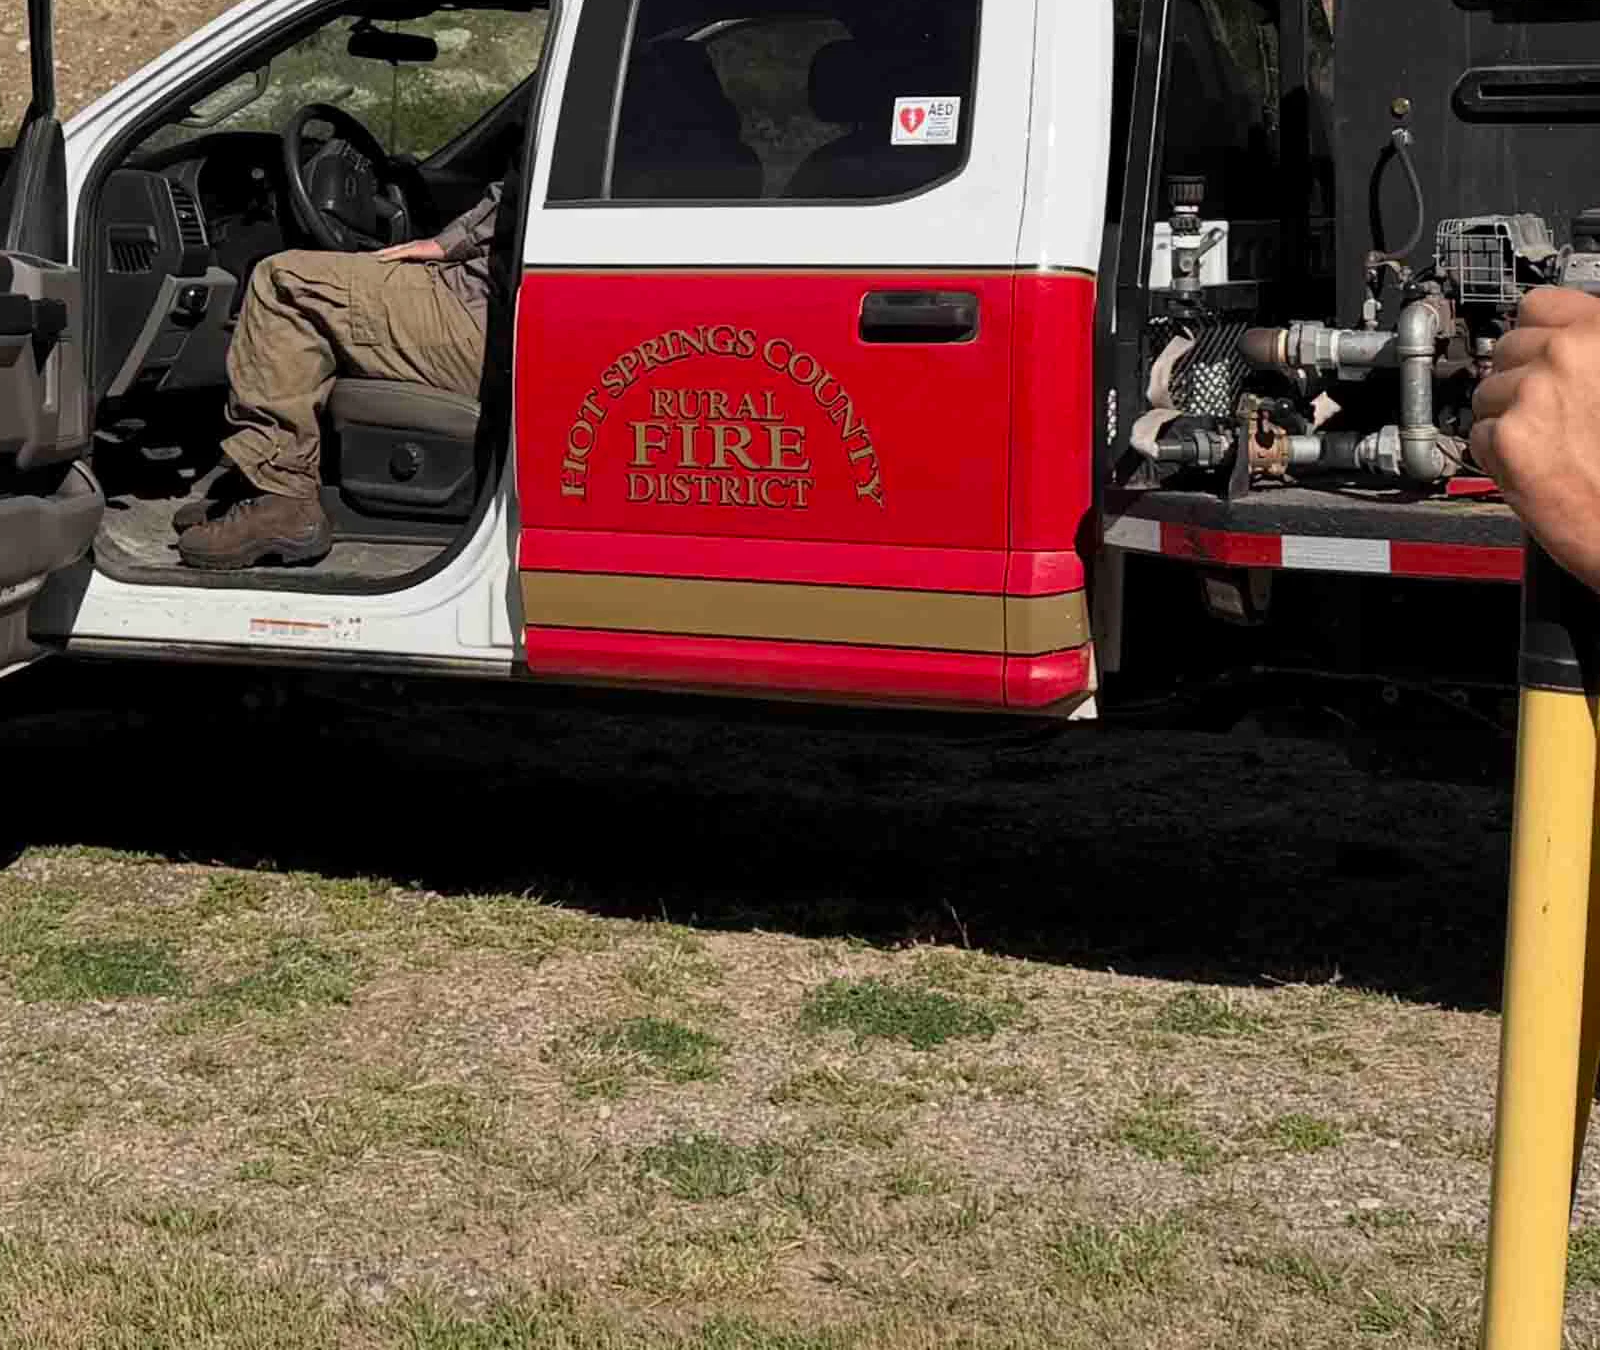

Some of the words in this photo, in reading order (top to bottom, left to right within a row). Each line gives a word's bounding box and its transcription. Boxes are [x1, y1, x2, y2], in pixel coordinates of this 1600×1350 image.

[927, 102, 954, 116] AED
[560, 387, 608, 500] HOT
[599, 324, 757, 399] SPRINGS
[763, 337, 884, 508] COUNTY
[651, 388, 785, 422] RURAL
[627, 419, 813, 472] FIRE
[627, 472, 815, 510] DISTRICT
